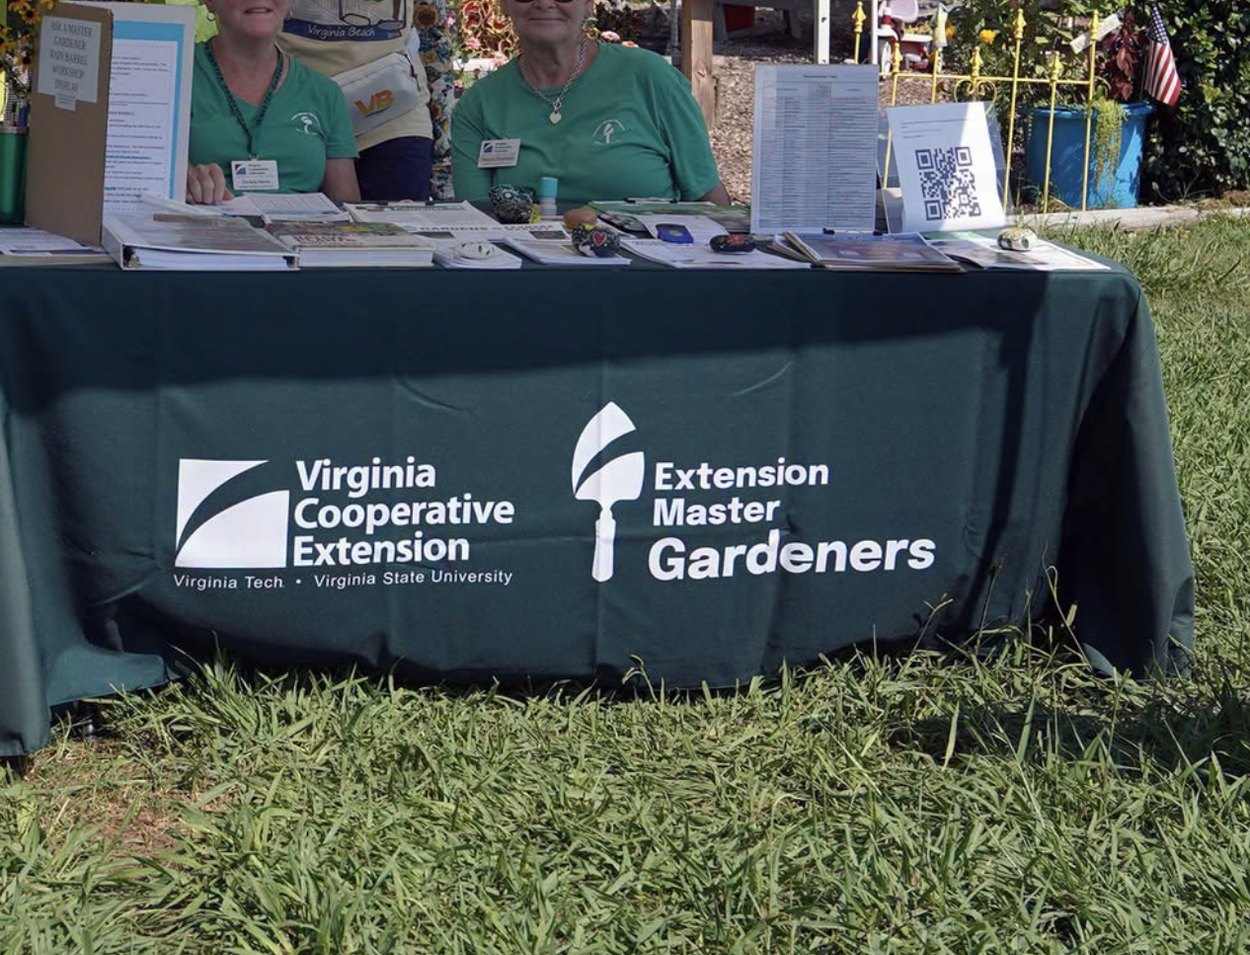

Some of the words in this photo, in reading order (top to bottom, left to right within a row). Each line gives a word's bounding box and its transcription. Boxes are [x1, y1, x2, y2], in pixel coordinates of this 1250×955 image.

[307, 25, 345, 39] Virginia
[348, 27, 375, 37] Beach
[354, 89, 395, 117] VB
[296, 456, 436, 498] Virginia
[655, 457, 829, 491] Extension
[294, 493, 515, 535] Cooperative
[653, 497, 781, 526] Master
[293, 530, 470, 567] Extension
[648, 528, 936, 581] Gardeners
[173, 574, 238, 591] Virginia
[245, 576, 283, 590] Tech
[314, 573, 376, 590] Virginia
[382, 570, 425, 585] State
[431, 568, 513, 585] University
